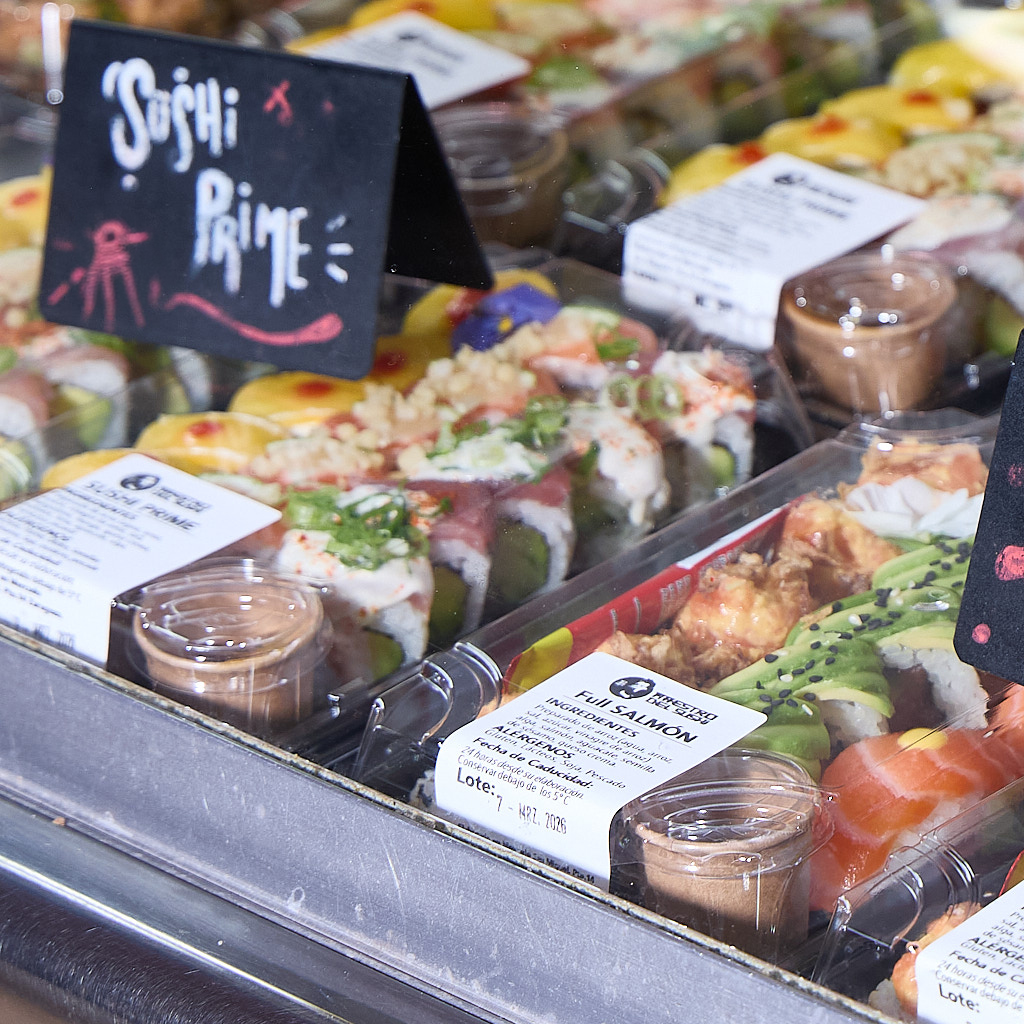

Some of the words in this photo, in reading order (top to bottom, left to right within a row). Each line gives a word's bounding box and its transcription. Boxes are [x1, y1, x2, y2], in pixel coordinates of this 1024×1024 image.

[546, 697, 640, 738] INGREDIENTES
[574, 690, 613, 708] Full
[609, 705, 698, 743] SALMÓN
[646, 697, 671, 711] DEL
[492, 726, 576, 759] ALÉRGENOS
[535, 704, 580, 725] Preparado
[594, 729, 616, 739] arroz
[616, 736, 646, 753] (agua,
[647, 751, 674, 764] arroz,
[540, 724, 574, 742] salmón,
[576, 739, 619, 761] aguacate,
[621, 757, 656, 774] semilla
[574, 729, 608, 748] vinagre
[609, 742, 623, 752] de
[622, 748, 652, 763] arroz)
[460, 746, 473, 756] 24
[473, 749, 499, 766] horas
[497, 759, 524, 775] desde
[522, 769, 534, 780] su
[472, 737, 508, 755] Fecha
[509, 751, 526, 762] de
[527, 759, 594, 789] Caducidad:
[484, 728, 518, 747] Gluten,
[560, 759, 583, 773] Soja,
[585, 769, 626, 789] Pescado
[557, 740, 587, 754] queso
[587, 751, 617, 767] crema.
[456, 766, 496, 796] Lote:
[457, 754, 498, 776] Conservar
[497, 770, 525, 788] debajo
[525, 780, 537, 792] de
[539, 785, 551, 799] los
[544, 812, 567, 835] 2026
[982, 930, 997, 939] de
[937, 960, 952, 970] 24
[950, 963, 977, 982] horas
[977, 974, 1007, 992] desde
[949, 950, 987, 969] Fecha
[989, 967, 1007, 977] de
[938, 983, 981, 1014] Lote:
